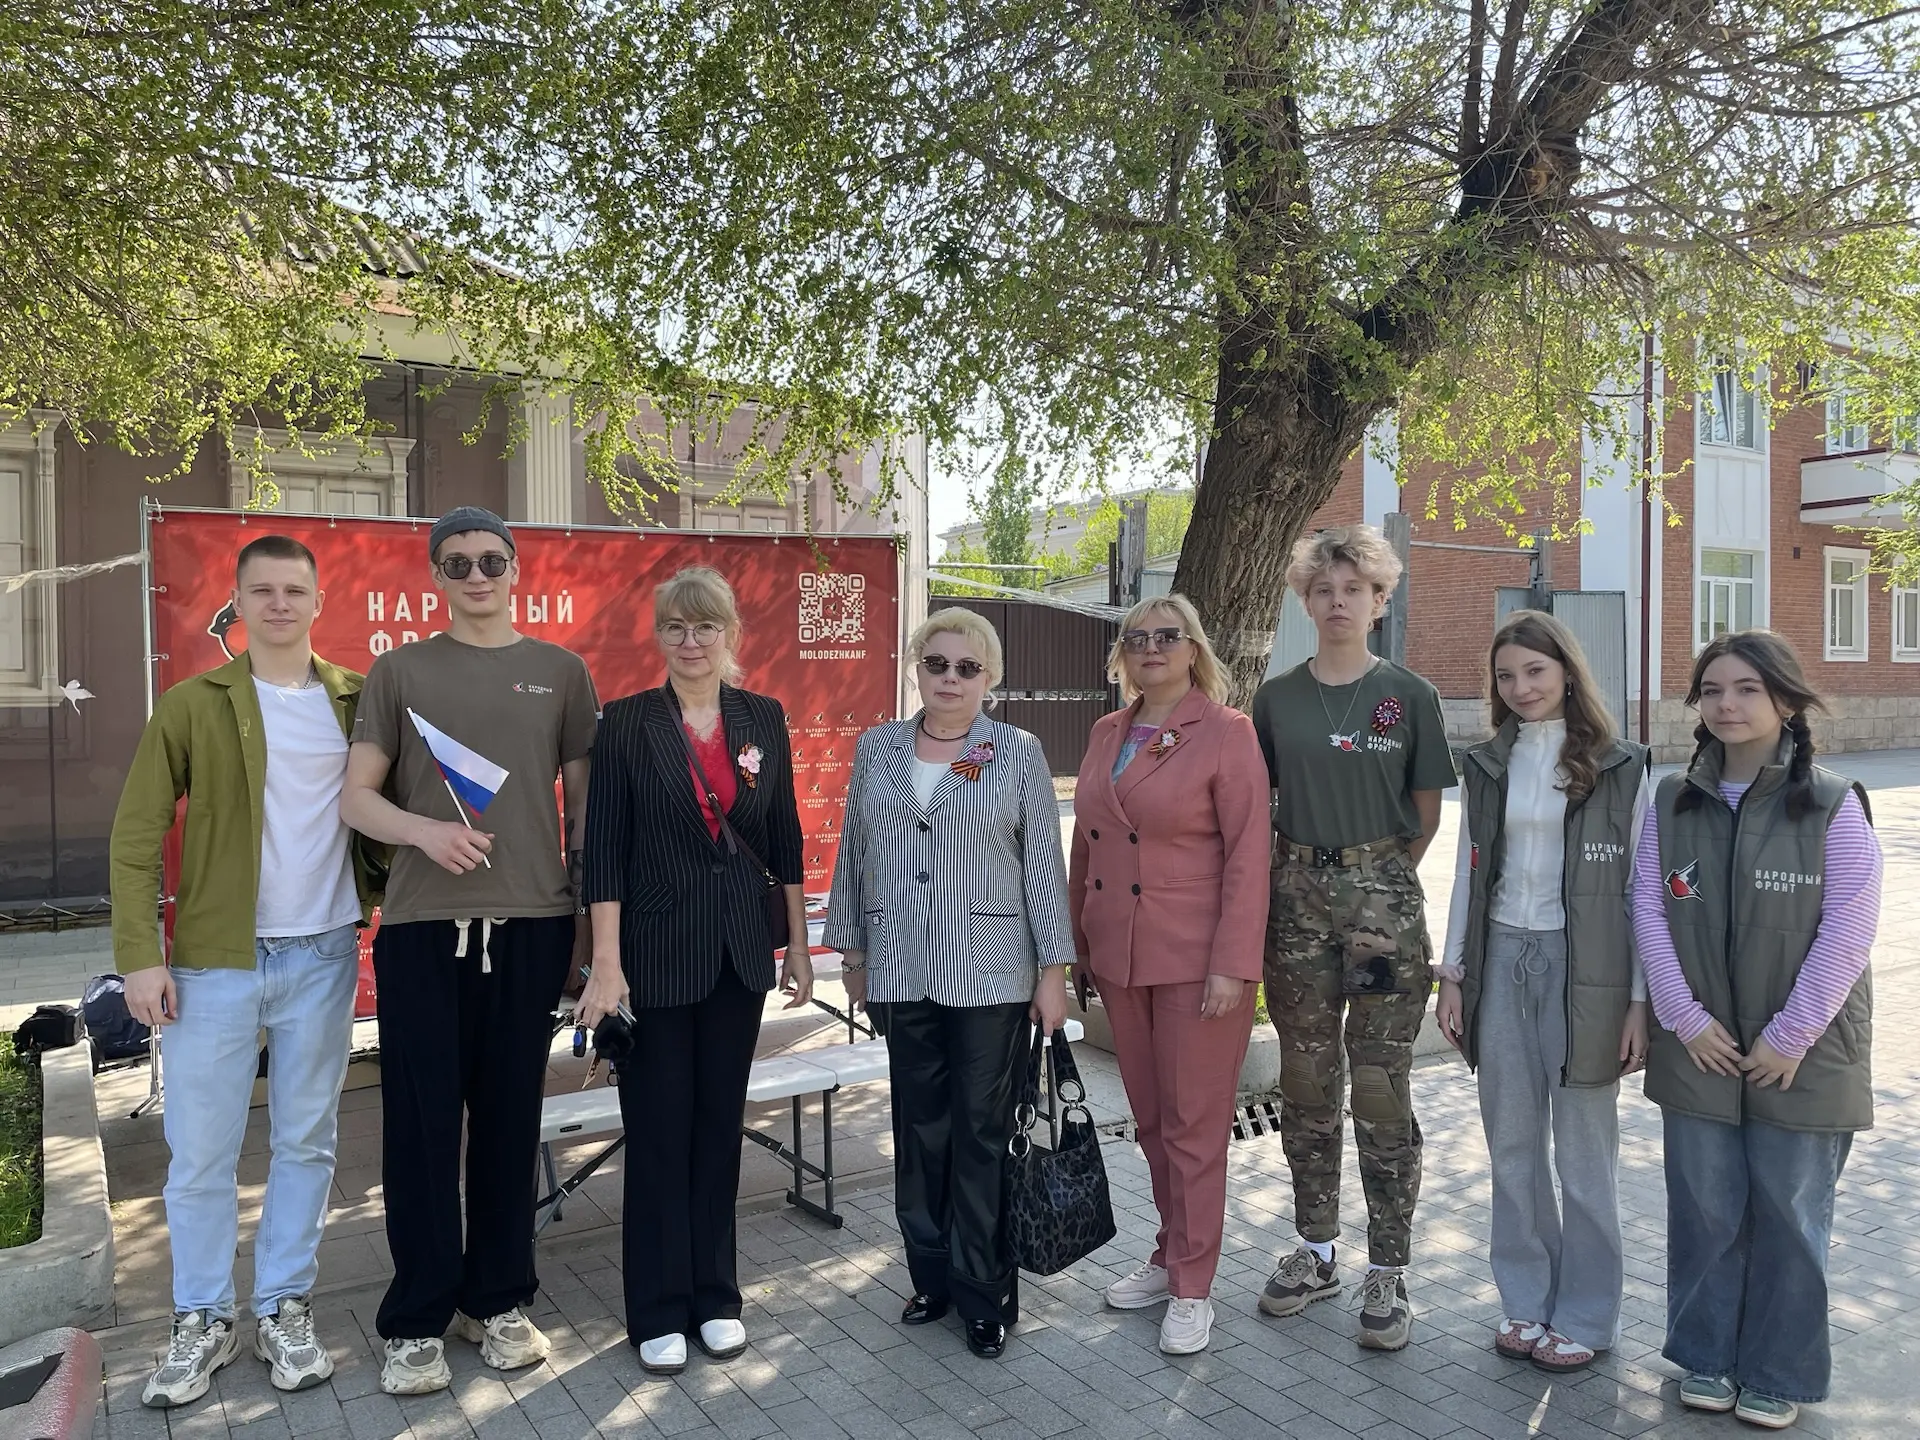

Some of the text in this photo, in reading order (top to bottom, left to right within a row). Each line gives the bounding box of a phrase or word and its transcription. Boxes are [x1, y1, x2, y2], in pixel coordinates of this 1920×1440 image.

[367, 590, 573, 623] НАРНЫЙ
[800, 650, 866, 659] MOLODEZHKANF
[1366, 742, 1391, 753] ФРОНТ
[1755, 869, 1821, 885] НАРОДНЫЙ
[1755, 880, 1796, 893] ФРОНТ
